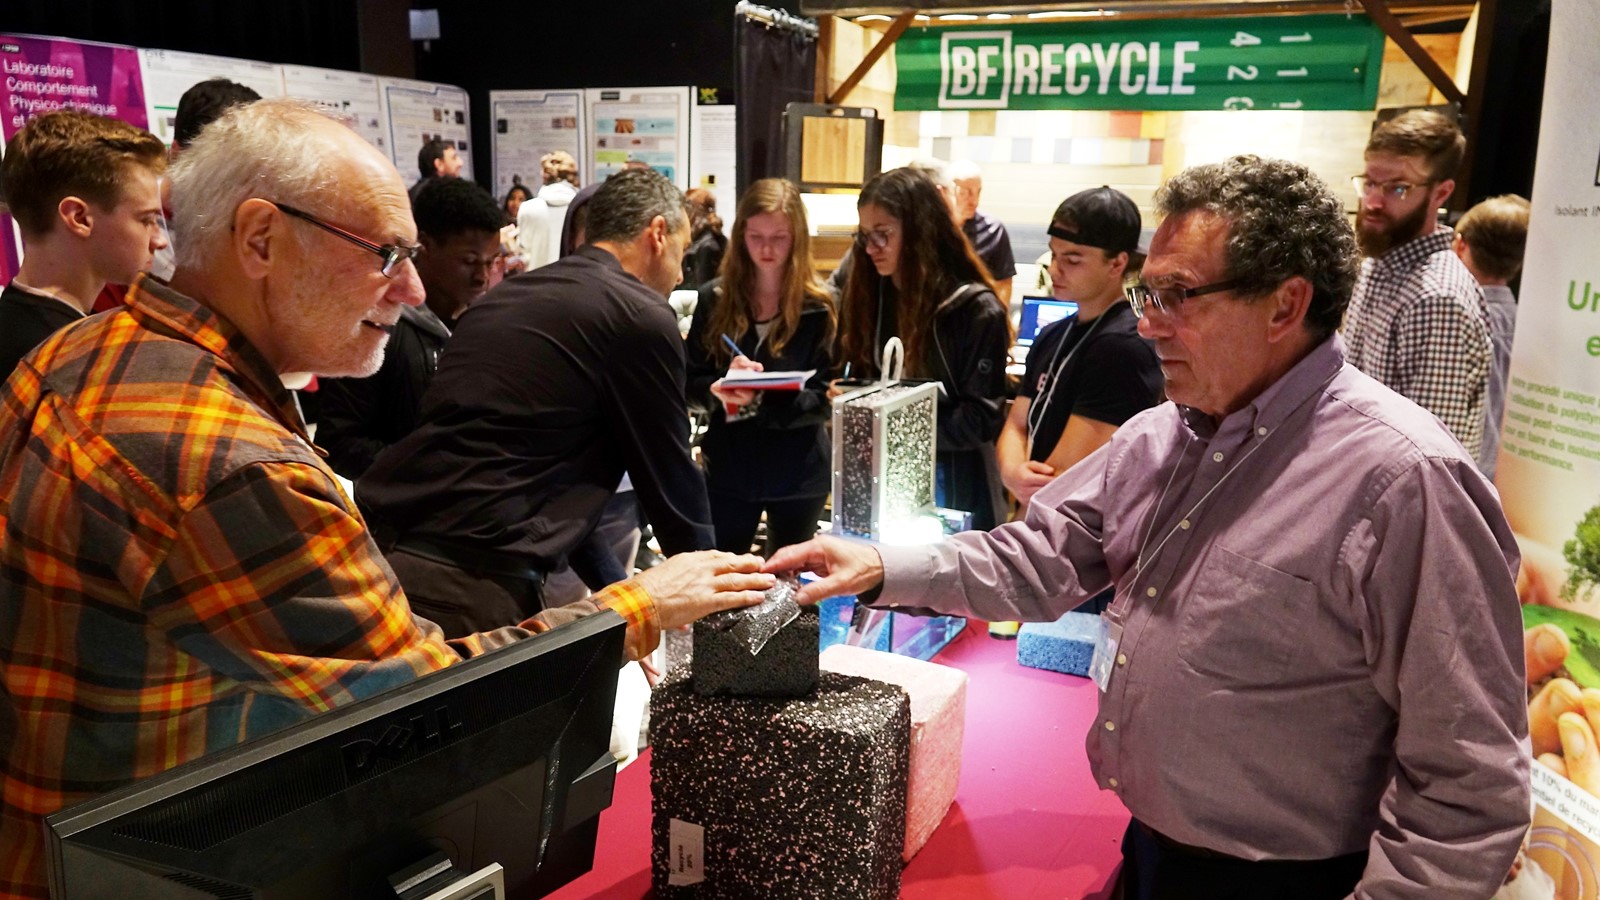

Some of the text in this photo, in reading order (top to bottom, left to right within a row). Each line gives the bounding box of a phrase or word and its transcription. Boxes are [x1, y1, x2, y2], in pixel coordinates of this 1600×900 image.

[3, 58, 74, 79] Laboratoire
[951, 41, 1200, 96] BF RECYCLE
[6, 75, 98, 98] Comportement
[12, 114, 26, 128] et
[340, 705, 462, 782] DELL
[1542, 771, 1562, 793] 10%
